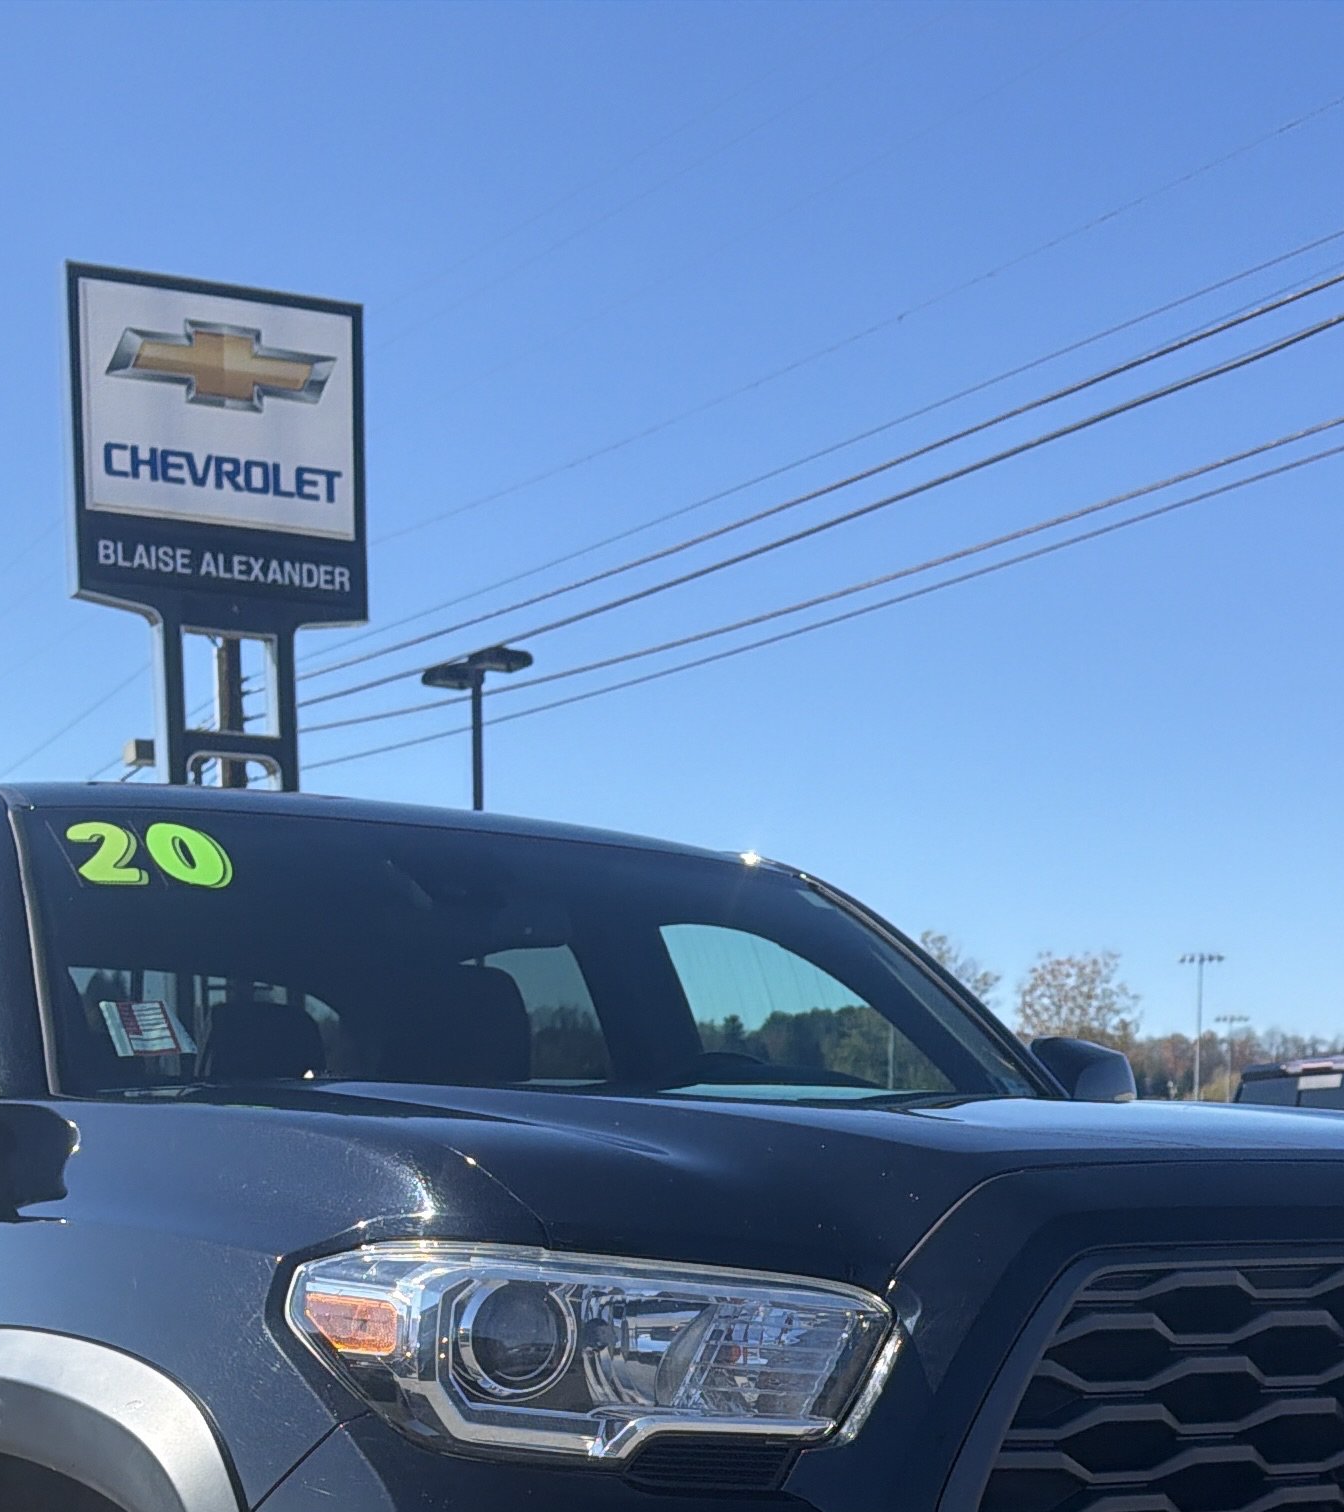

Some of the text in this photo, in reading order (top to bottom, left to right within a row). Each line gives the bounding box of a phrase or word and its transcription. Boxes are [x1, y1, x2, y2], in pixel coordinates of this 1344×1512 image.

[103, 442, 342, 503] CHEVROLET
[97, 539, 351, 592] BLAISE ALEXANDER
[66, 821, 233, 888] 20
